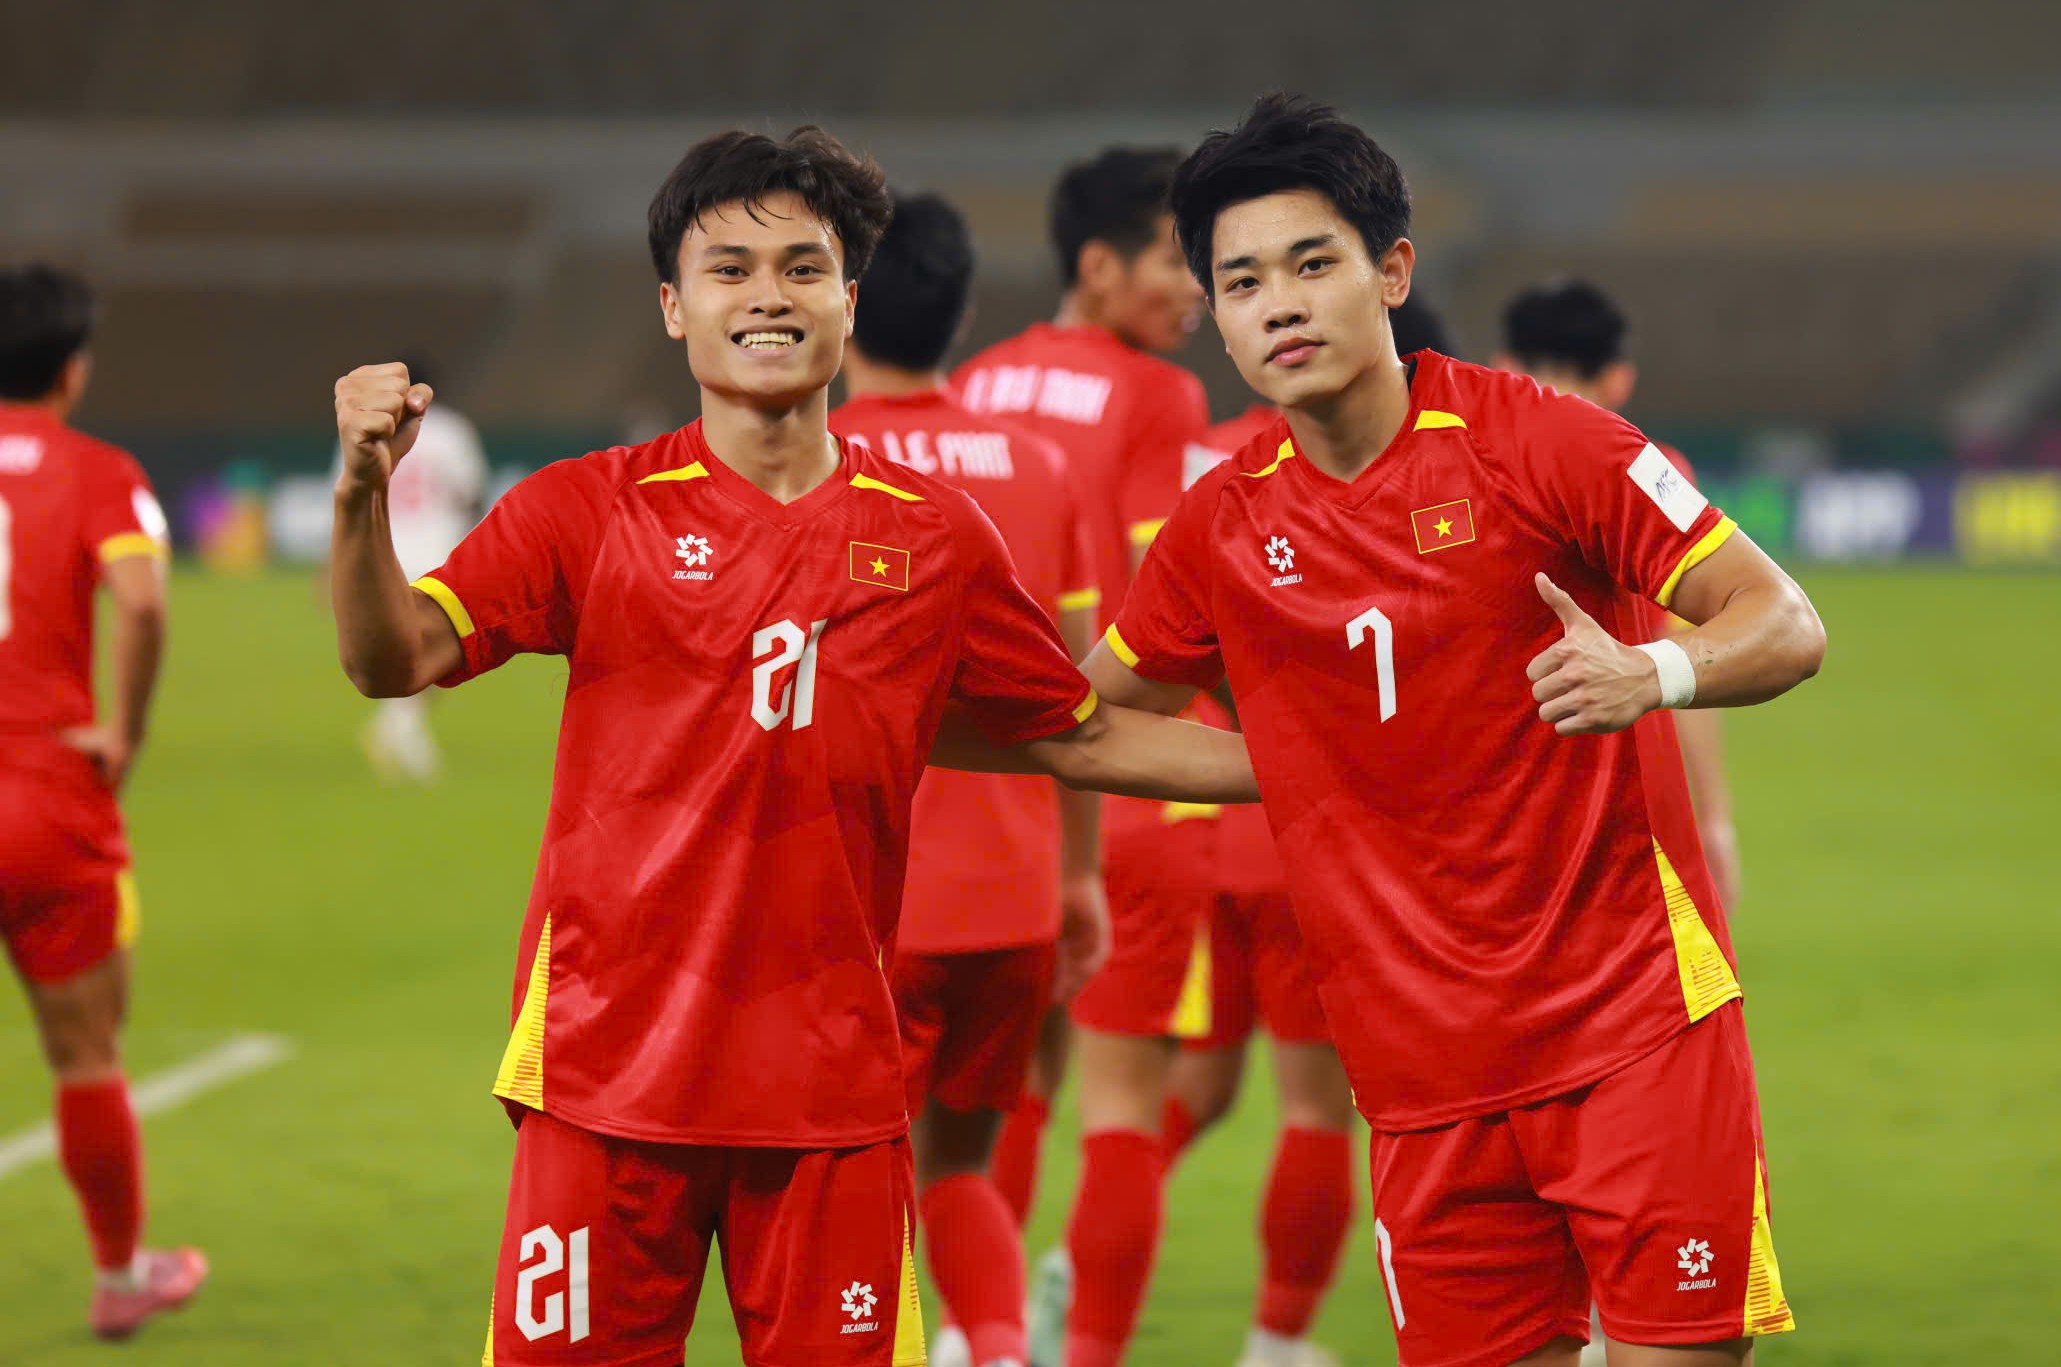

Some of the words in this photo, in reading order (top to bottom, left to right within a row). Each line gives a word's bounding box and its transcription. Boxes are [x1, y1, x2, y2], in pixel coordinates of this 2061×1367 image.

[750, 618, 829, 732] 21
[1345, 606, 1397, 724] 7
[514, 1223, 590, 1345] 21
